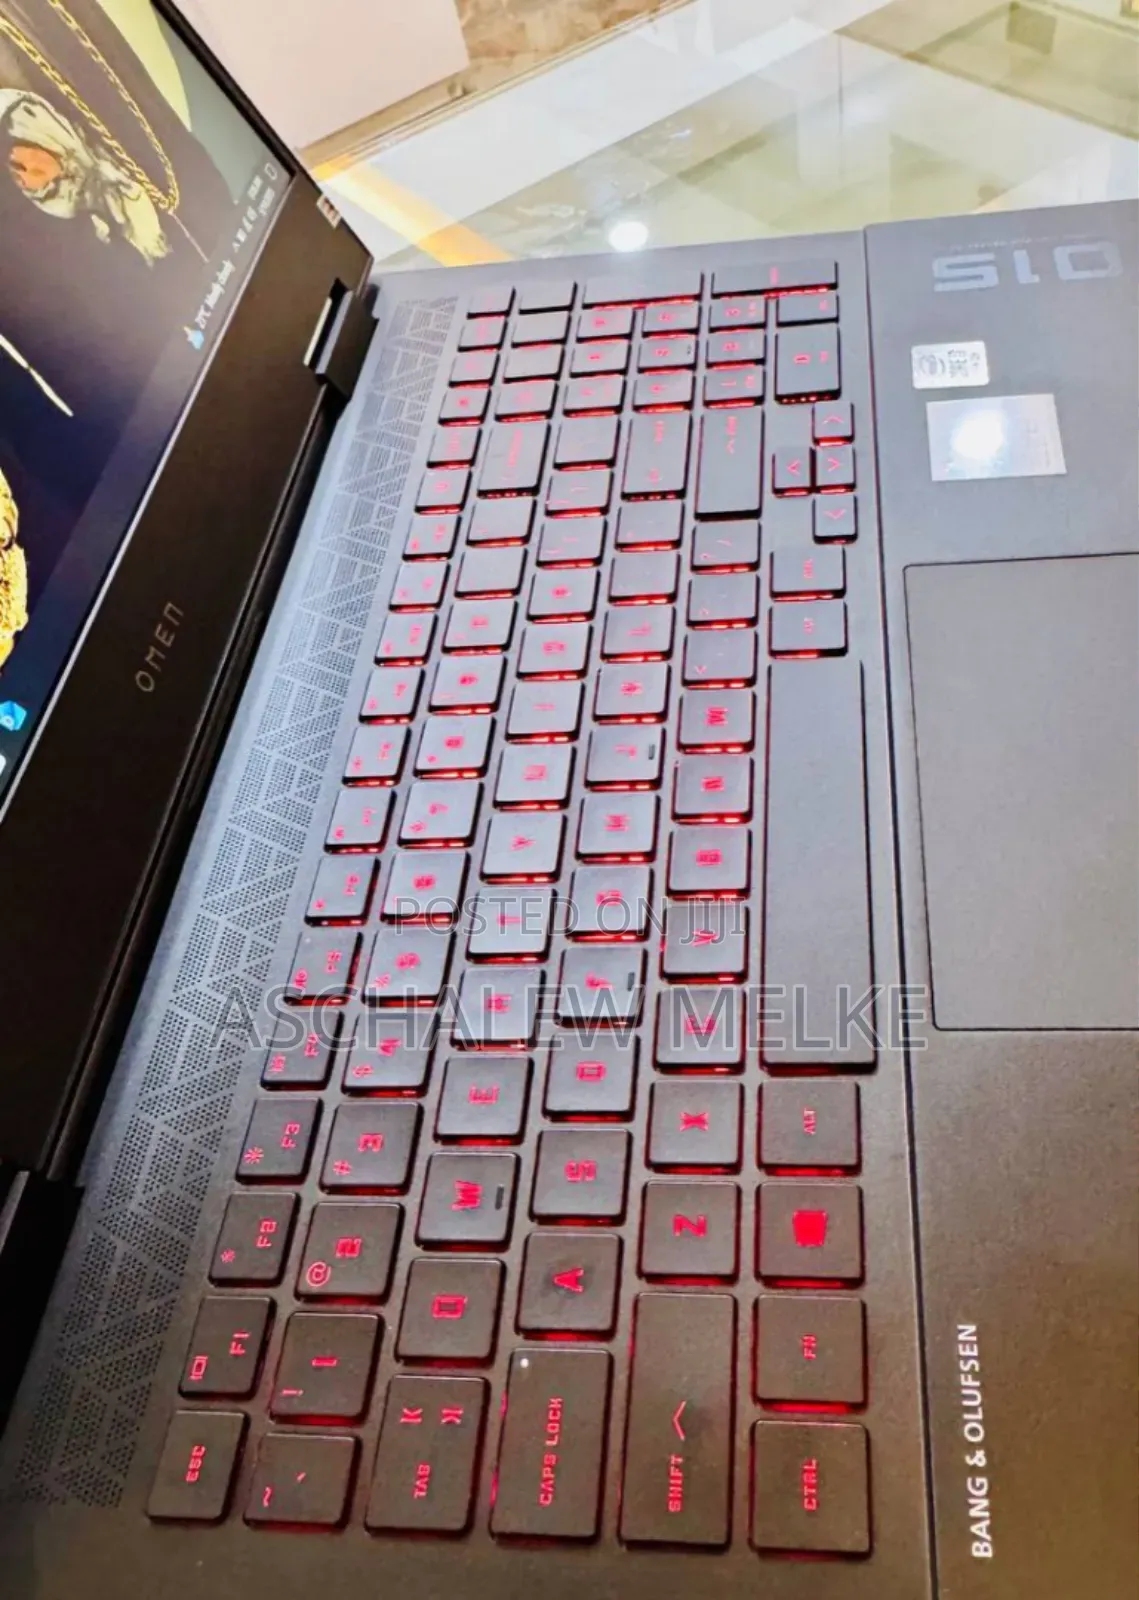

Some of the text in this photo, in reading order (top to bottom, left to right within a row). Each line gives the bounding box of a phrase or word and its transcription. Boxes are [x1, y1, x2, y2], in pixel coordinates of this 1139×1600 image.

[135, 602, 184, 692] OMEN
[605, 814, 628, 831] H
[511, 836, 533, 850] Y
[696, 849, 722, 866] B
[693, 929, 717, 946] V
[395, 953, 420, 970] 5
[585, 973, 610, 990] F
[486, 994, 510, 1012] R
[684, 1015, 717, 1035] C
[379, 1038, 400, 1056] 4
[468, 1086, 499, 1104] E
[681, 1113, 708, 1130] X
[281, 1121, 300, 1149] F3
[358, 1133, 383, 1152] 3
[564, 1160, 596, 1183] S
[453, 1181, 482, 1209] W
[255, 1218, 277, 1248] F2
[673, 1215, 707, 1237] Z
[336, 1237, 361, 1257] 2
[307, 1262, 330, 1287] @
[554, 1268, 582, 1292] A
[230, 1330, 248, 1356] F1
[802, 1334, 816, 1360] FN
[539, 1398, 562, 1506] CAPS LOCK
[957, 1324, 993, 1558] BANG & OLUFSEN
[184, 1445, 206, 1483] ESC
[412, 1462, 431, 1497] TAB
[667, 1455, 683, 1512] SHIFT
[802, 1460, 819, 1511] CTRL
